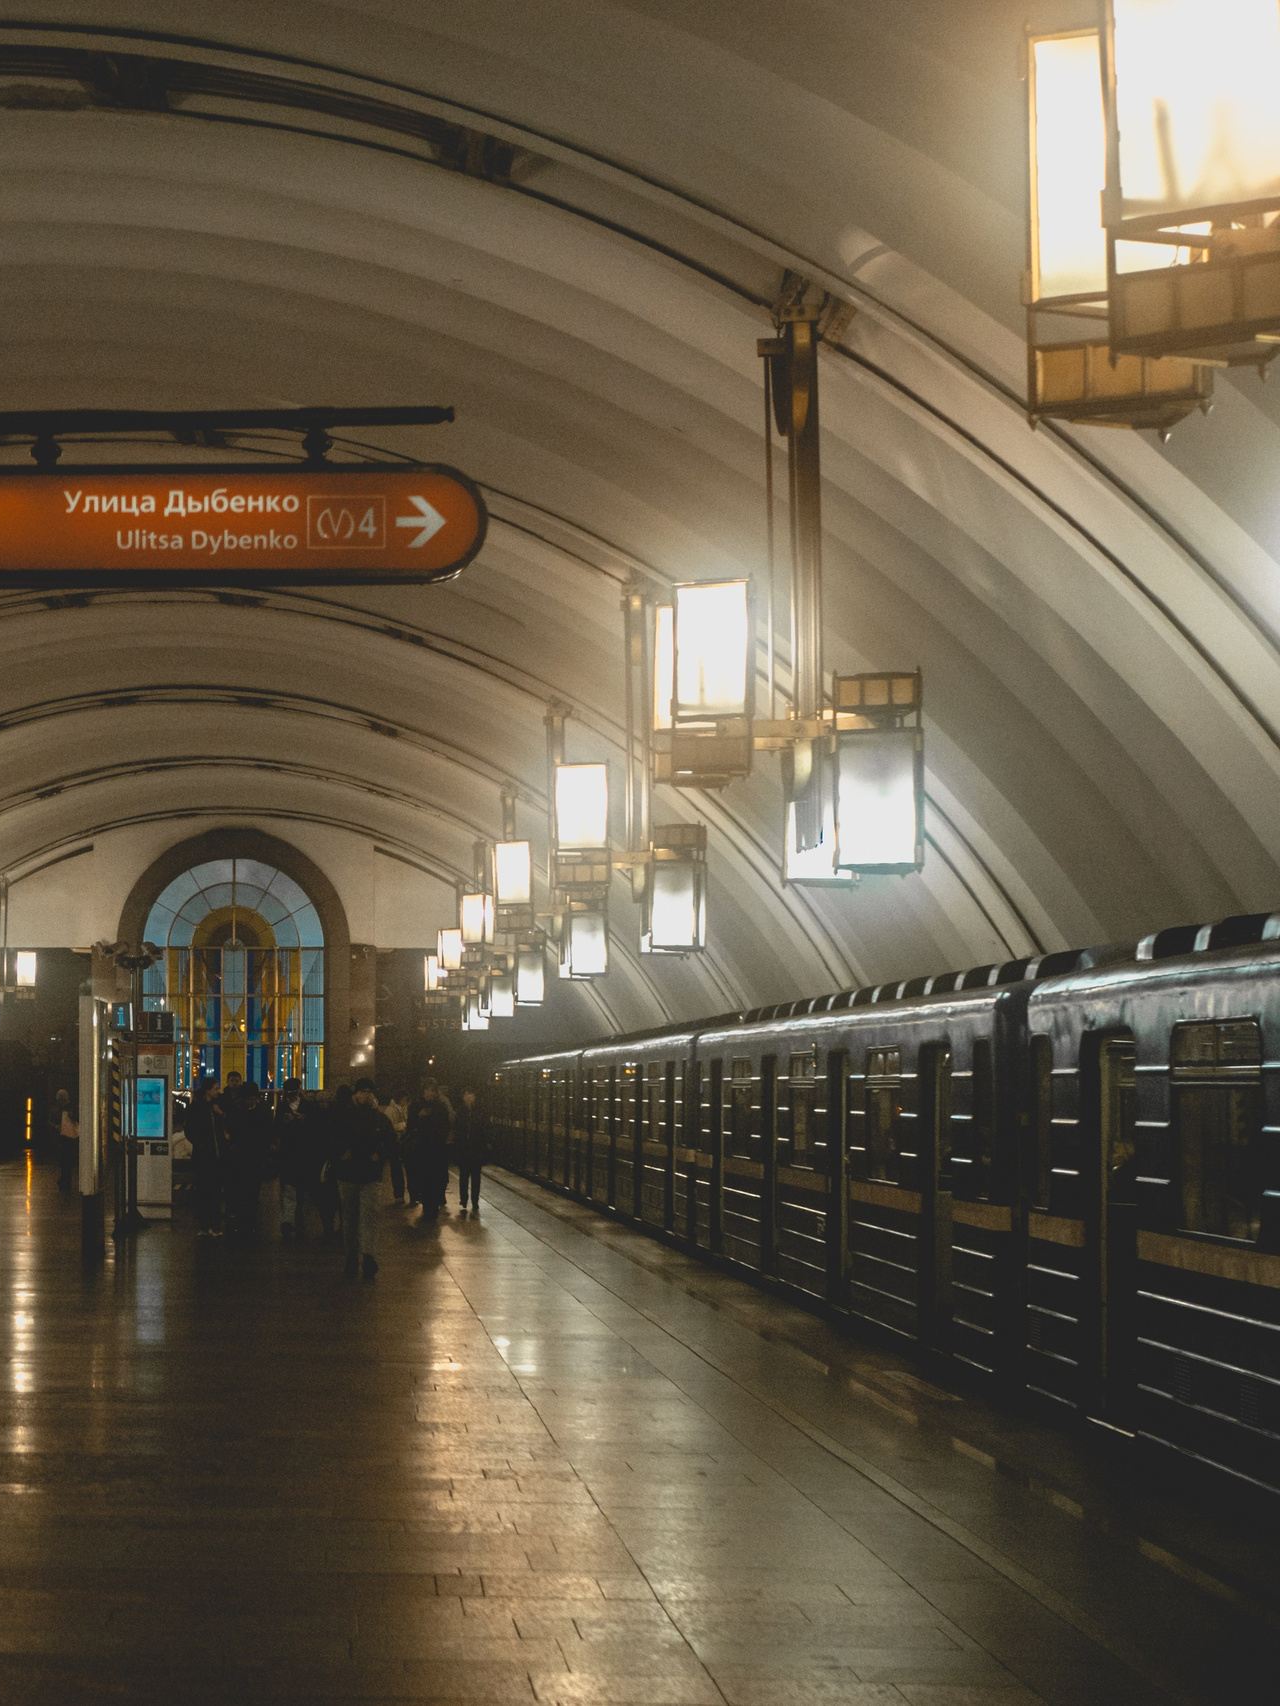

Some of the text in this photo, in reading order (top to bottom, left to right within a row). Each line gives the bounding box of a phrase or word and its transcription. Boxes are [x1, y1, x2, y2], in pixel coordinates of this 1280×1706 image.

[63, 488, 300, 518] Улица Дыбенко
[116, 529, 298, 555] Ulitsa Dybenko
